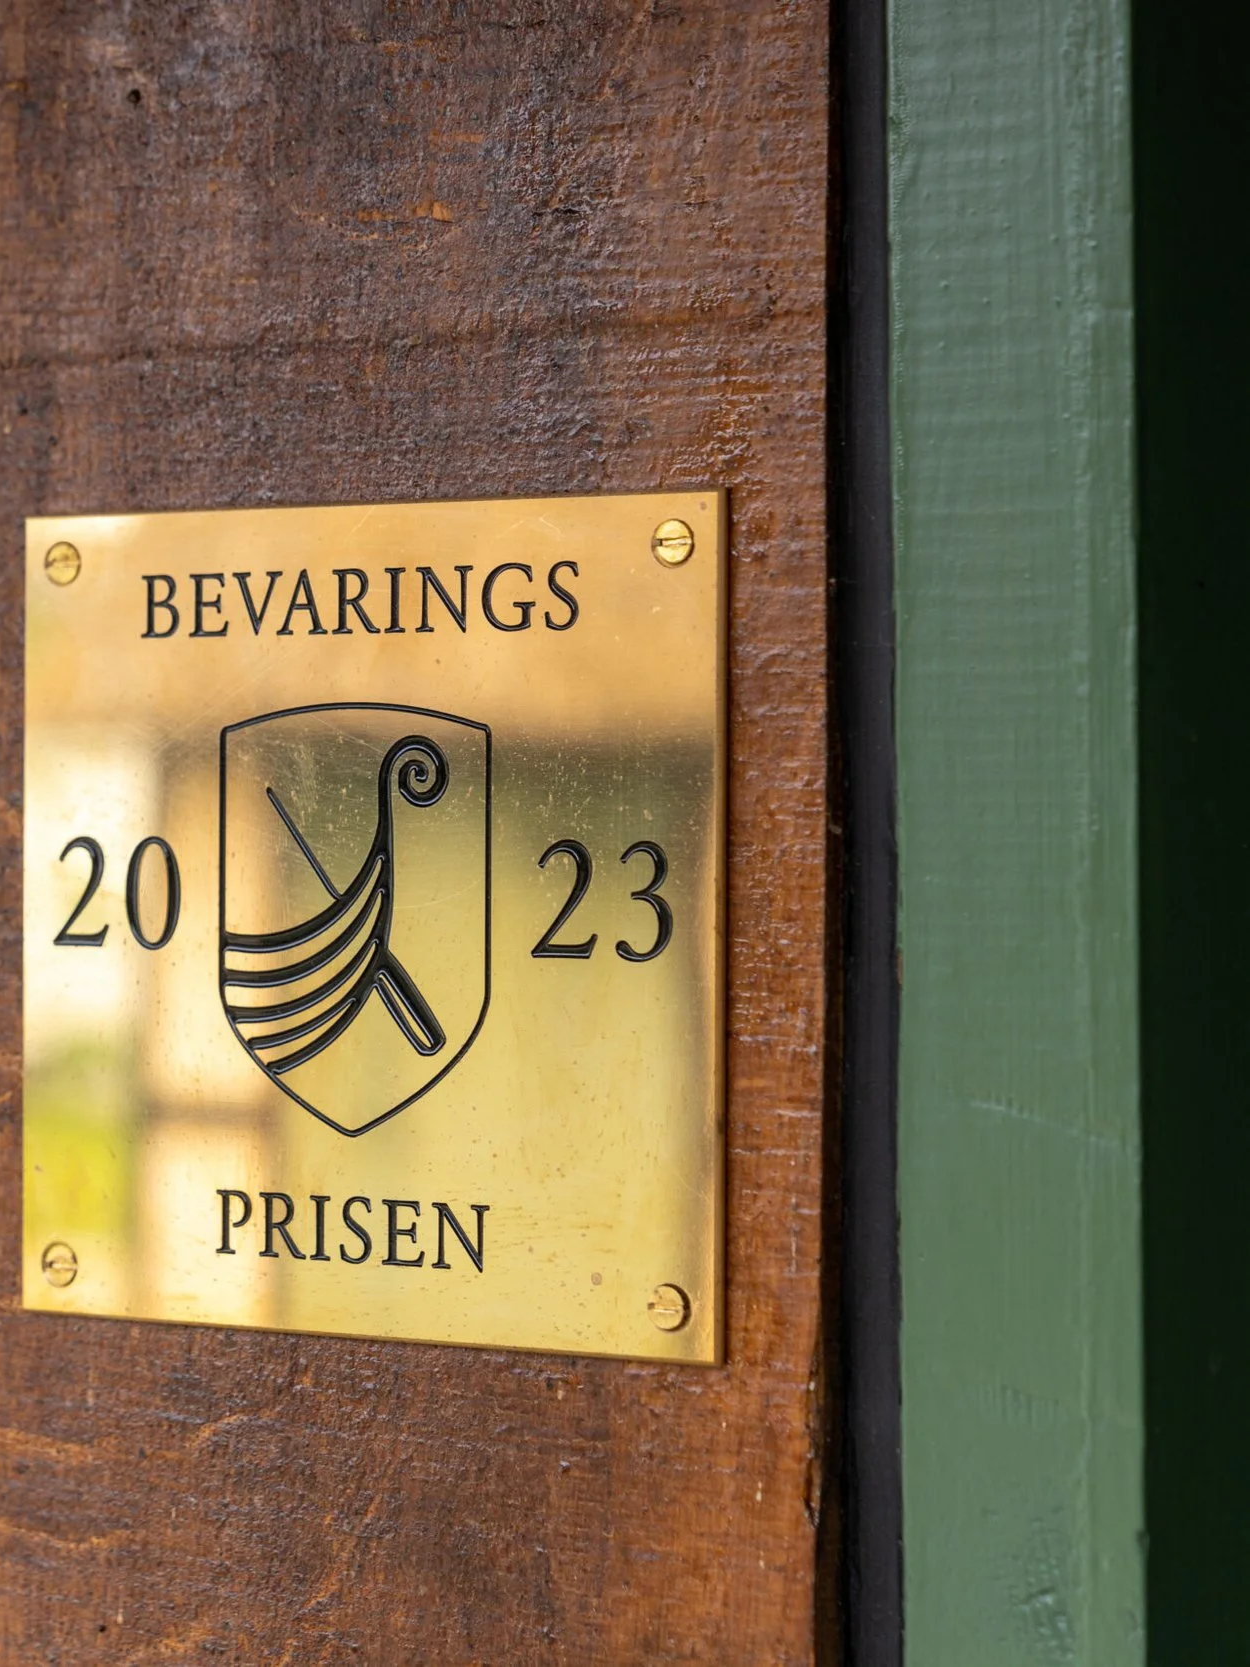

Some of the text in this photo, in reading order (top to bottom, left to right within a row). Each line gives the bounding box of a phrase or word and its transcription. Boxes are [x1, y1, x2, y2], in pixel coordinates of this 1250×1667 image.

[140, 559, 581, 640] BEVARINGS
[52, 834, 675, 964] 20 23
[215, 1187, 491, 1275] PRISEN
